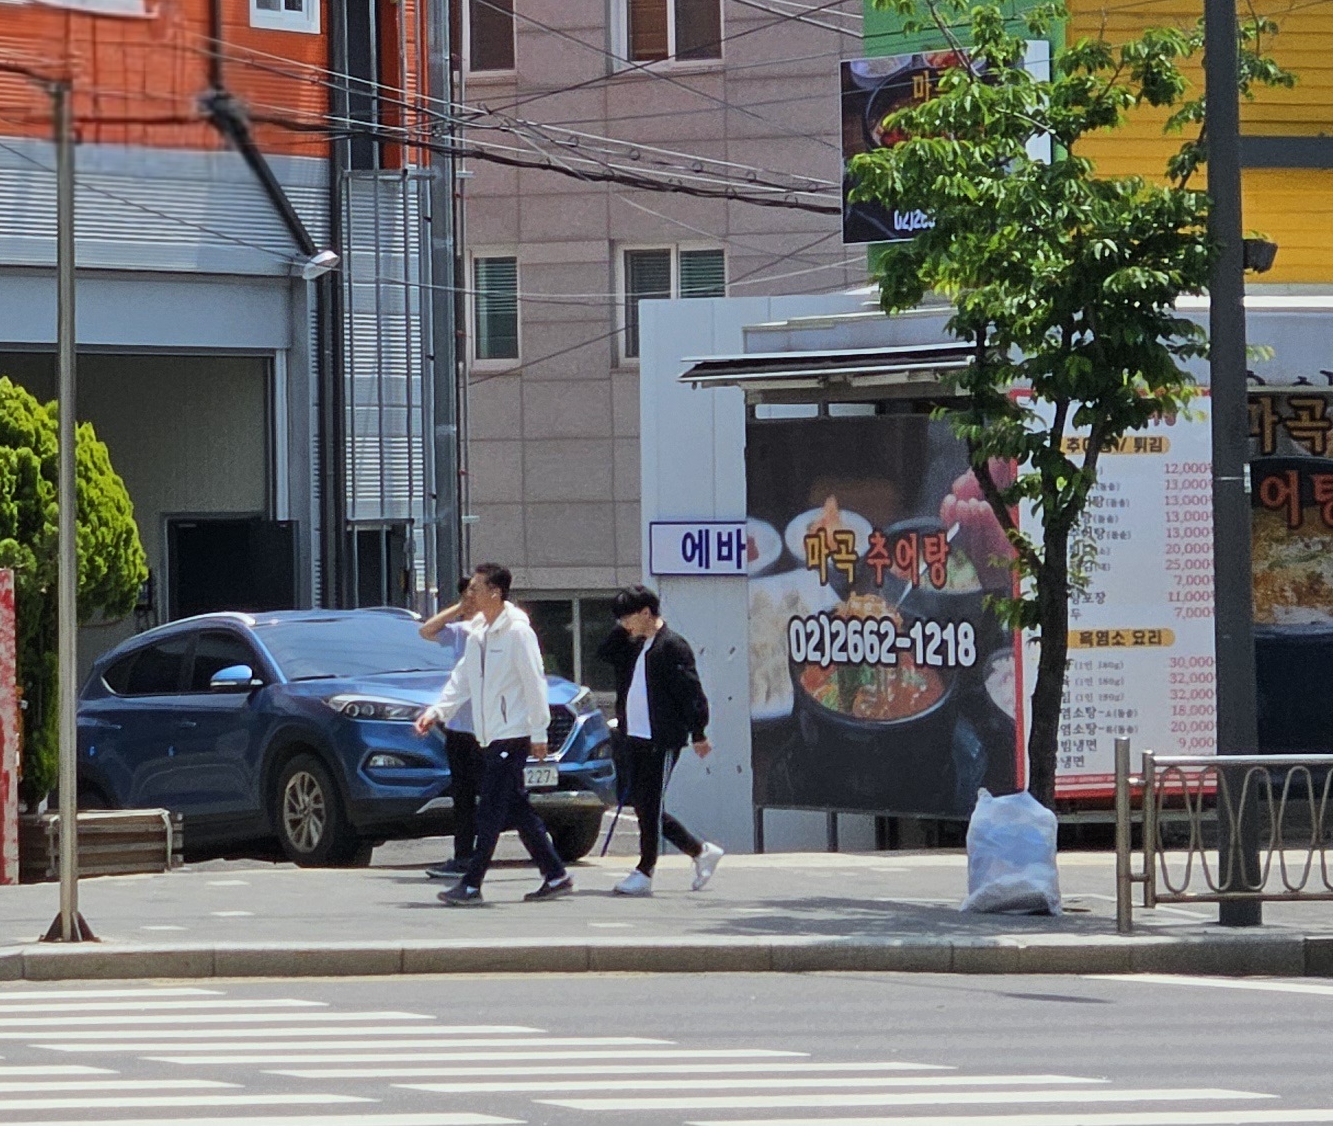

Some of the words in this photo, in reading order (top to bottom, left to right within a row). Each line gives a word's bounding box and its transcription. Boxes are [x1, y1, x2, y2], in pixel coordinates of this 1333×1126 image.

[805, 528, 857, 585] 마곡
[867, 529, 950, 589] 추어탕
[788, 613, 978, 668] 02)2662-1218
[1132, 629, 1163, 646] 요리
